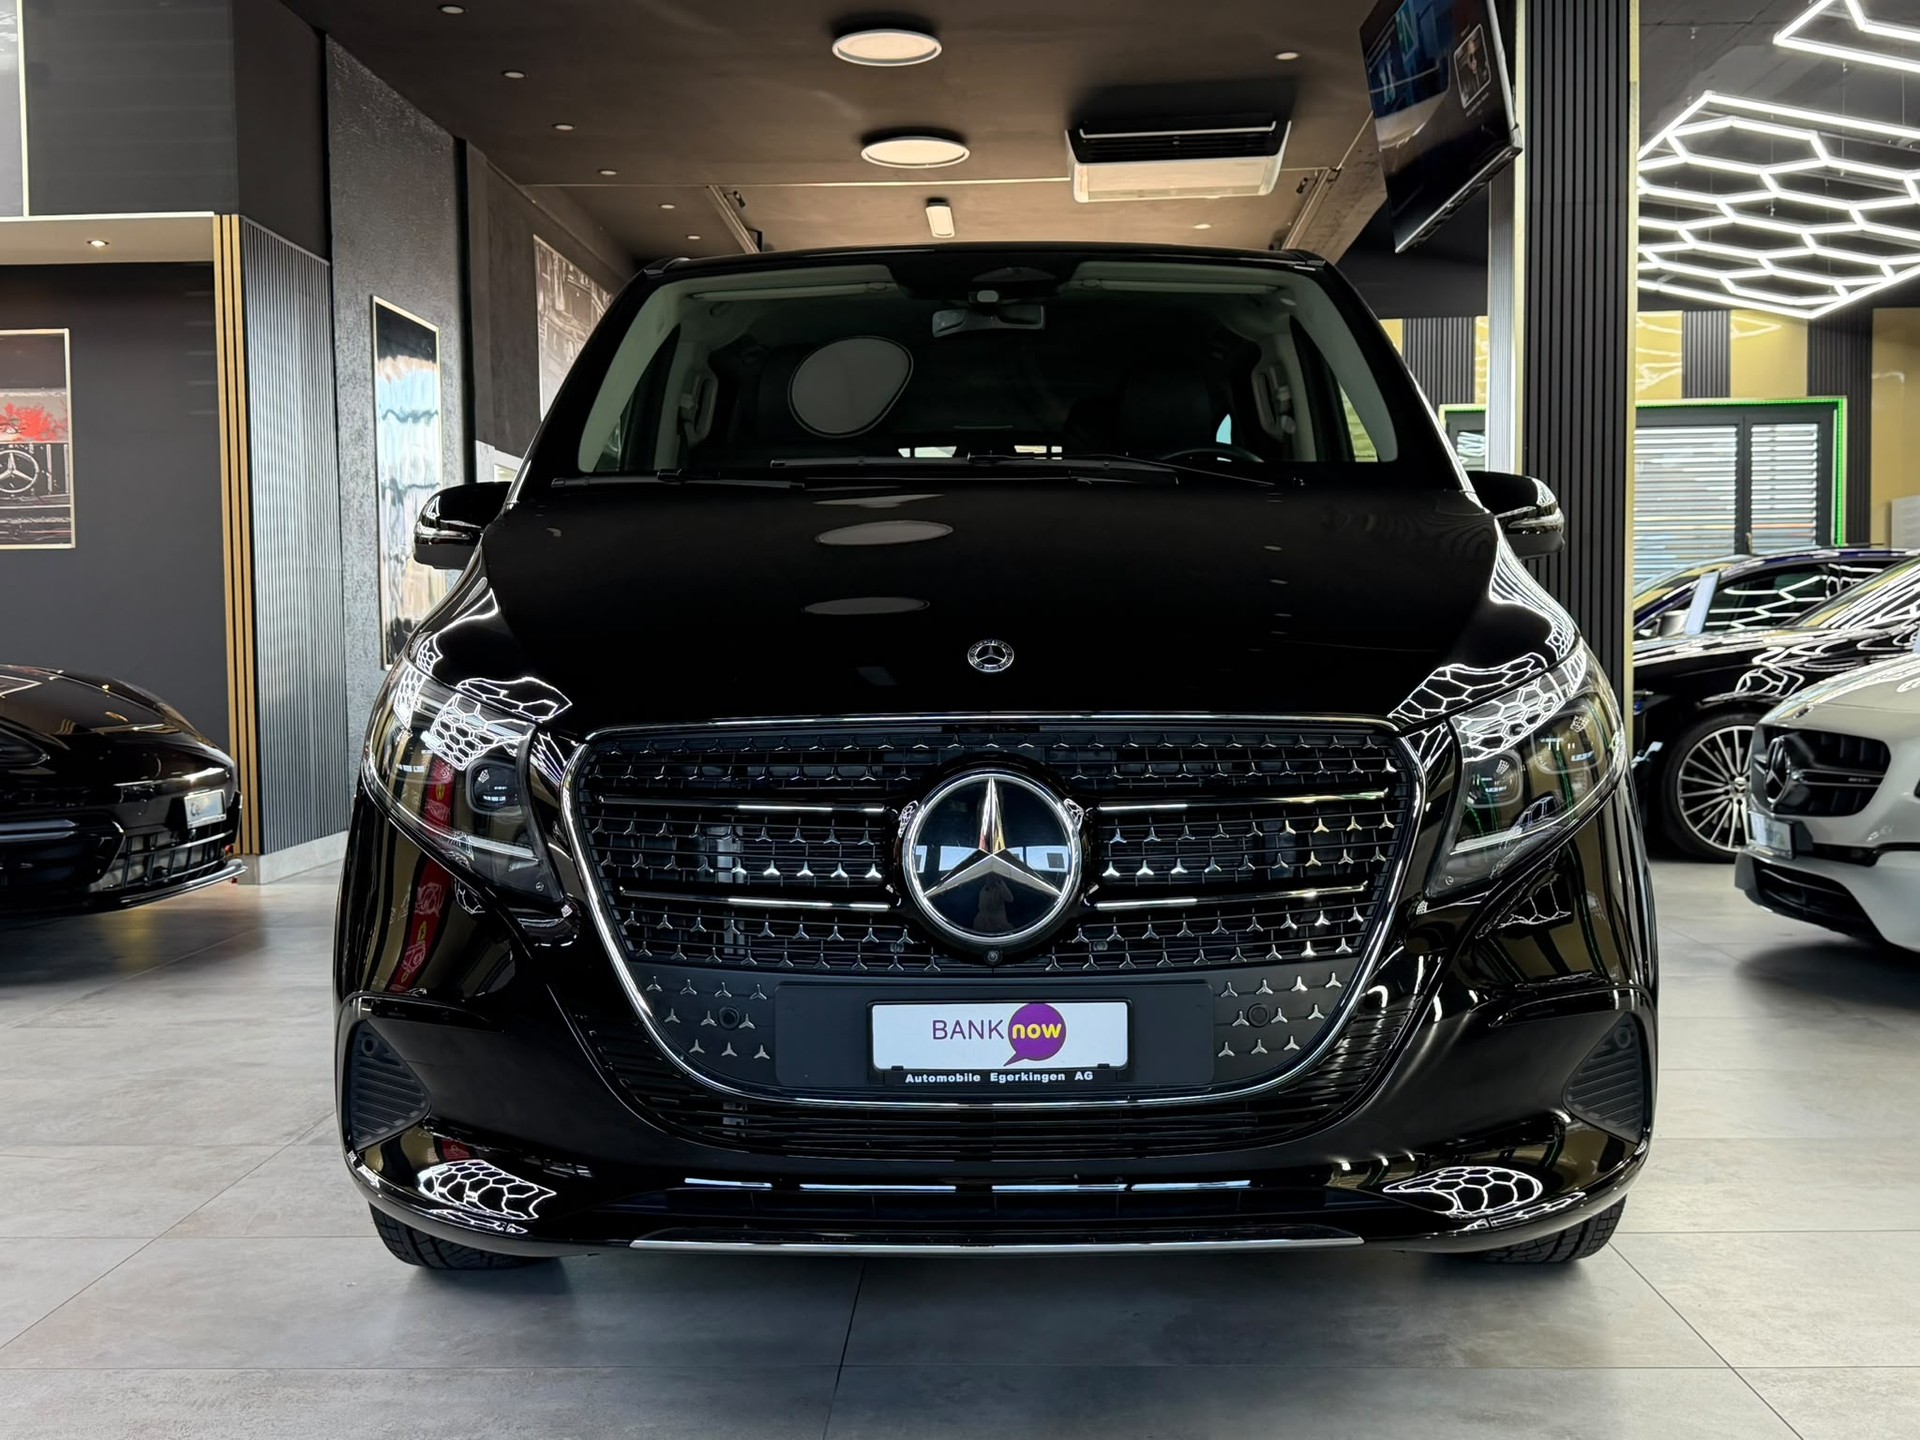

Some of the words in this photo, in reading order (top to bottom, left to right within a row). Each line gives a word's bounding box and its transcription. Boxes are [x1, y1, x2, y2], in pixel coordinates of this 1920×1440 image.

[932, 1019, 1005, 1040] BANK
[1012, 1023, 1062, 1040] now
[905, 1072, 981, 1084] Automobile
[990, 1071, 1066, 1084] Egerkingen
[1074, 1071, 1094, 1081] AG
